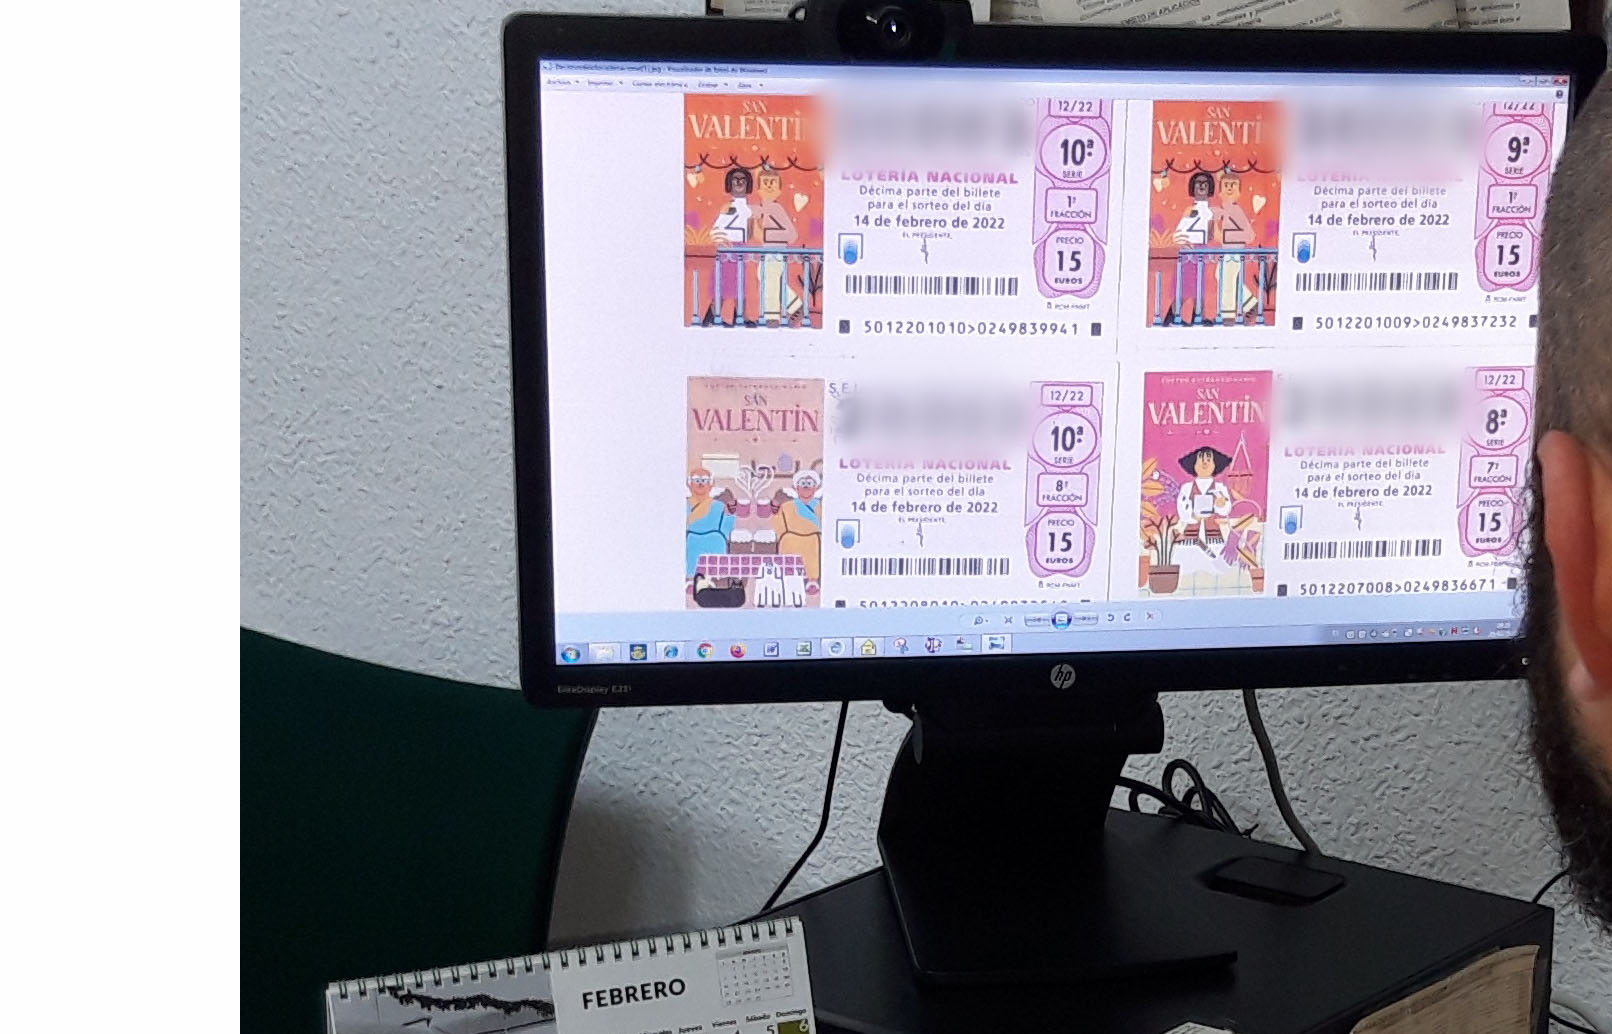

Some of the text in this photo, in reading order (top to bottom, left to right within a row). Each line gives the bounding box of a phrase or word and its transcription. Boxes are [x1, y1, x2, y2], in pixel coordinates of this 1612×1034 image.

[1058, 101, 1092, 112] 12/22
[1206, 106, 1231, 119] SAN
[927, 171, 1019, 184] NACIONAL
[859, 185, 1001, 199] Décima parte del billete
[1314, 185, 1447, 197] Décima parte del billete
[868, 202, 894, 212] para
[898, 200, 908, 210] el
[912, 201, 948, 211] sorteo
[953, 200, 970, 211] del
[1321, 200, 1347, 210] para
[1350, 198, 1359, 208] el
[1362, 199, 1397, 209] sorteo
[1401, 199, 1417, 209] del
[854, 215, 1005, 229] 14 de febrero de 2022
[1308, 213, 1450, 226] 14 de febrero de 2022
[1496, 231, 1523, 239] PRECIO
[1057, 251, 1082, 272] 15
[1497, 245, 1520, 265] 15
[1484, 374, 1516, 385] 12/22
[744, 392, 768, 407] SAN
[1050, 390, 1084, 401] 12/22
[1197, 388, 1220, 400] SAN
[1362, 444, 1446, 456] NACIONAL
[923, 458, 1011, 470] NACIONAL
[1300, 458, 1429, 471] Décima parte del billete
[857, 473, 994, 486] Décima parte del billete
[1307, 472, 1332, 483] para
[1335, 471, 1344, 481] el
[1348, 472, 1381, 481] sorteo
[1385, 471, 1401, 480] del
[865, 487, 891, 497] para
[894, 487, 904, 496] el
[908, 488, 945, 496] sorteo
[950, 487, 965, 496] del
[1295, 485, 1432, 499] 14 de febrero de 2022
[851, 501, 999, 513] 14 de febrero de 2022
[1048, 519, 1075, 527] PRECIO
[1479, 512, 1501, 532] 15
[1048, 532, 1072, 552] 15
[1050, 663, 1076, 690] hp
[582, 978, 686, 1009] FEBRERO
[799, 1019, 808, 1032] 6
